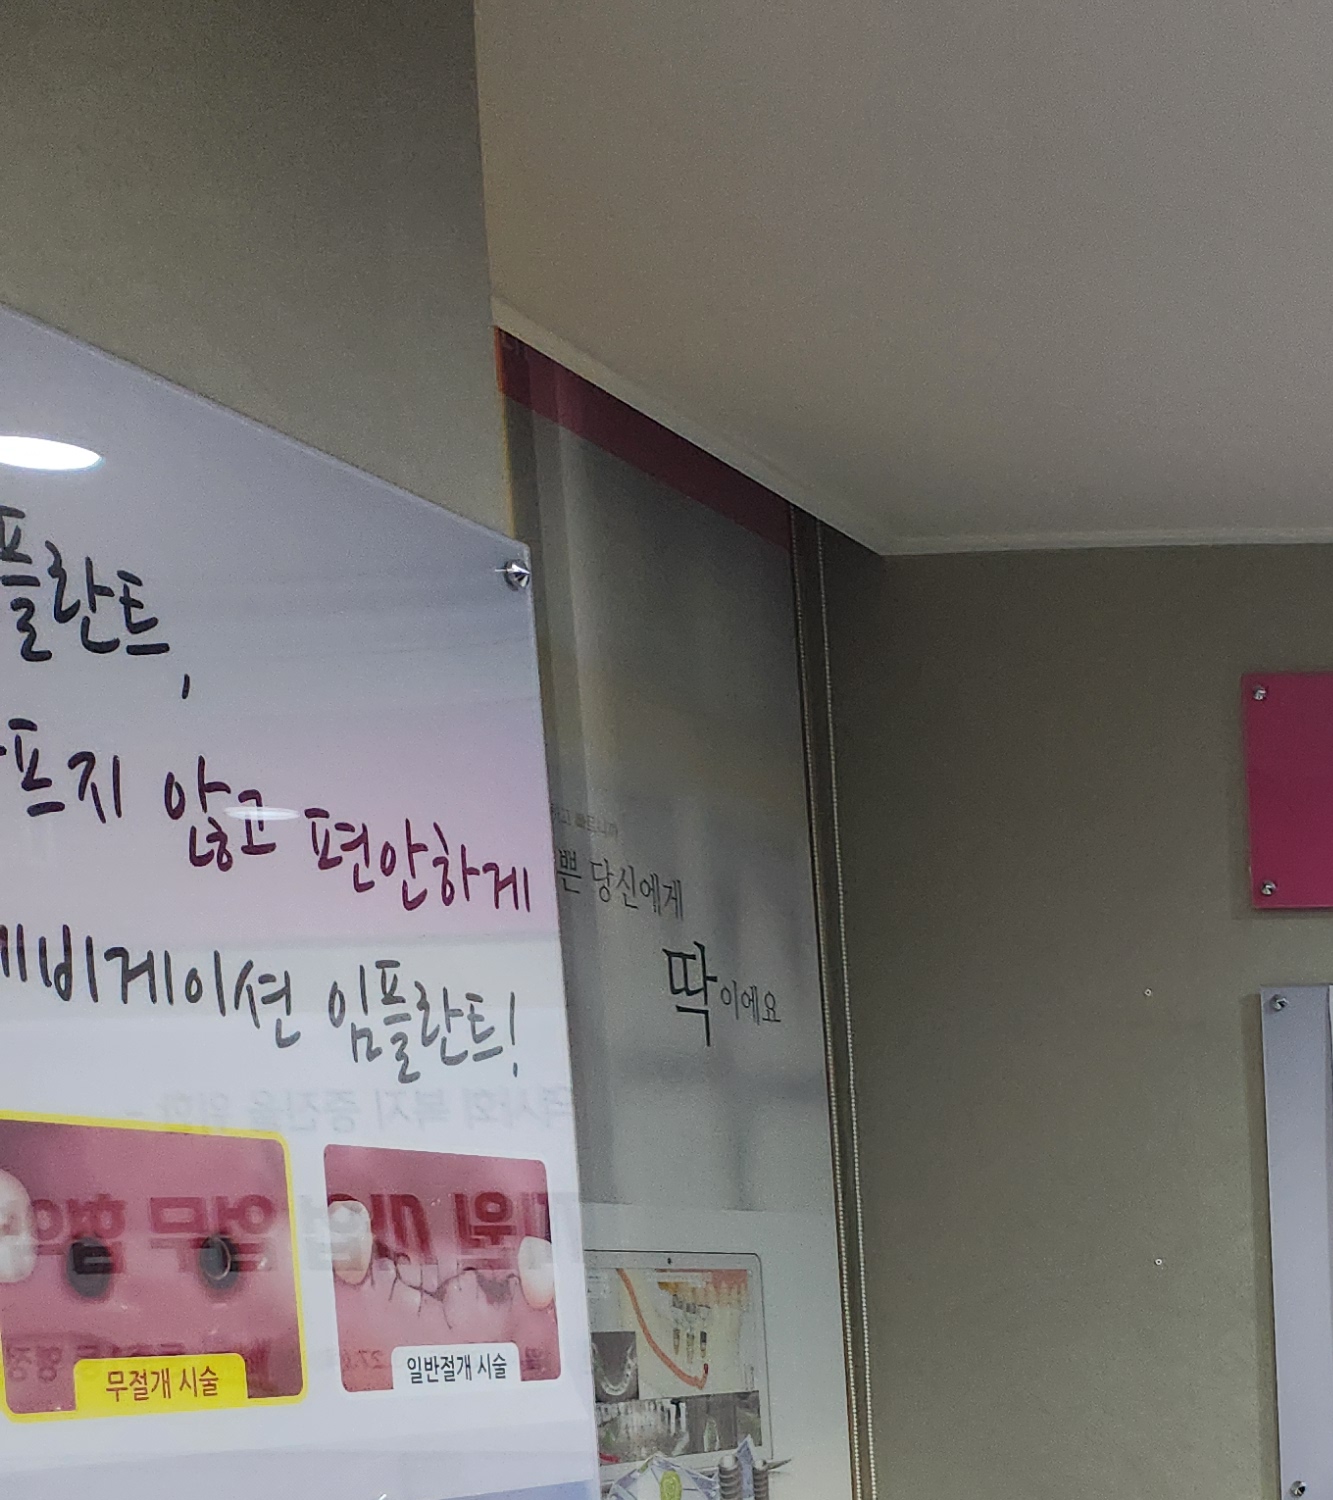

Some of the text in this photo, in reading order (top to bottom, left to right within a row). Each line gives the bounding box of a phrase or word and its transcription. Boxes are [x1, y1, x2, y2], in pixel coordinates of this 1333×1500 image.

[0, 717, 531, 913] 프지 않고 편안하게
[556, 849, 684, 921] 쁜 당신에게
[328, 960, 519, 1084] 임플란트!
[105, 1365, 219, 1402] 무절개 시술
[406, 1352, 508, 1385] 일반절개 시술
